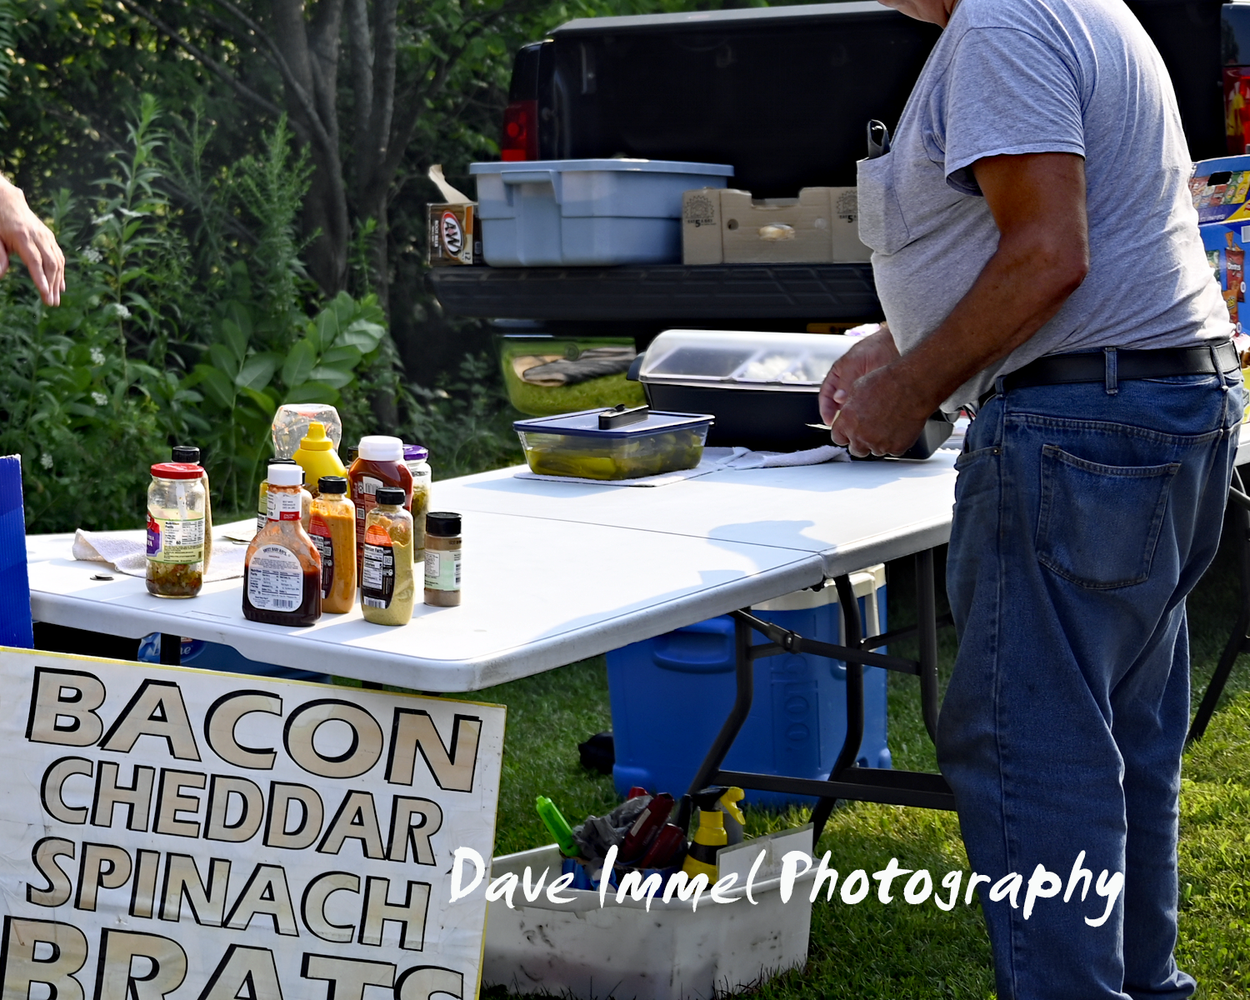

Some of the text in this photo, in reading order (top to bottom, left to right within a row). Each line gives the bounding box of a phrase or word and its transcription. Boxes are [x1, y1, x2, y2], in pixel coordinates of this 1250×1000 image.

[24, 665, 483, 794] BACON
[39, 755, 444, 867] CHEDDAR
[25, 835, 433, 952] SPINACH
